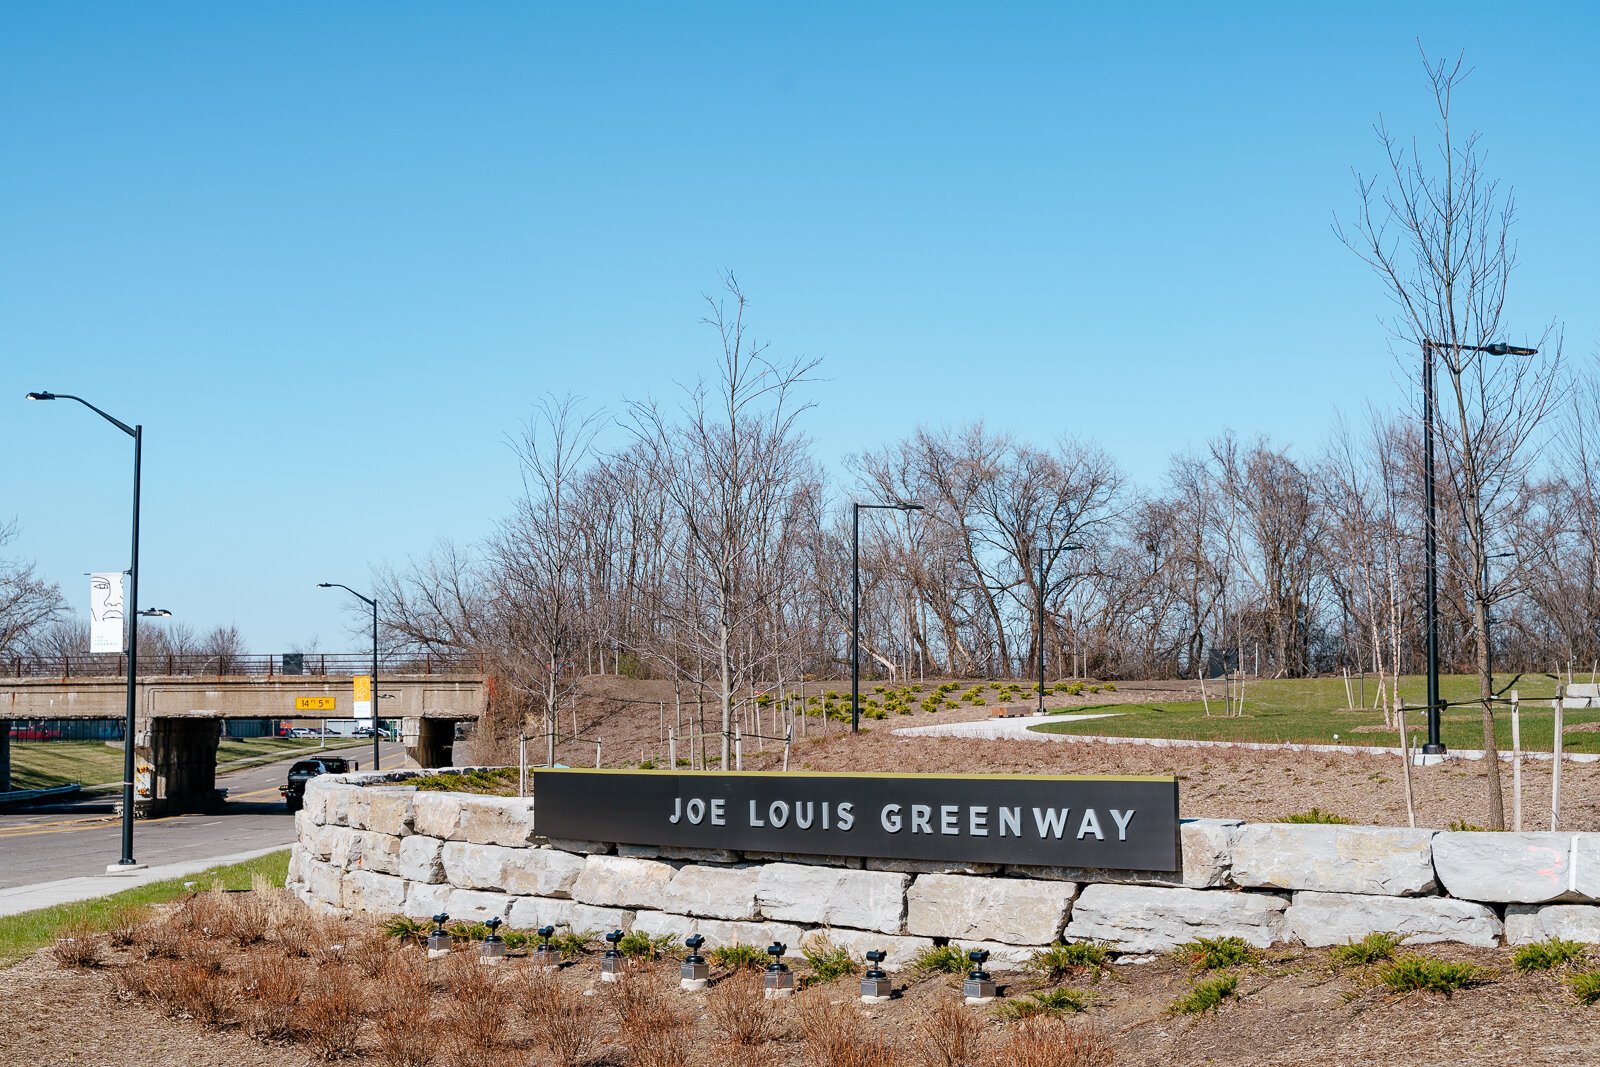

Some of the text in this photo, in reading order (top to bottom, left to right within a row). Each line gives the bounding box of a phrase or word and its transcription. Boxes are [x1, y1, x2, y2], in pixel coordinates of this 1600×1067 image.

[302, 700, 309, 708] 14
[668, 797, 1136, 842] JOE LOUIS GREENWAY
